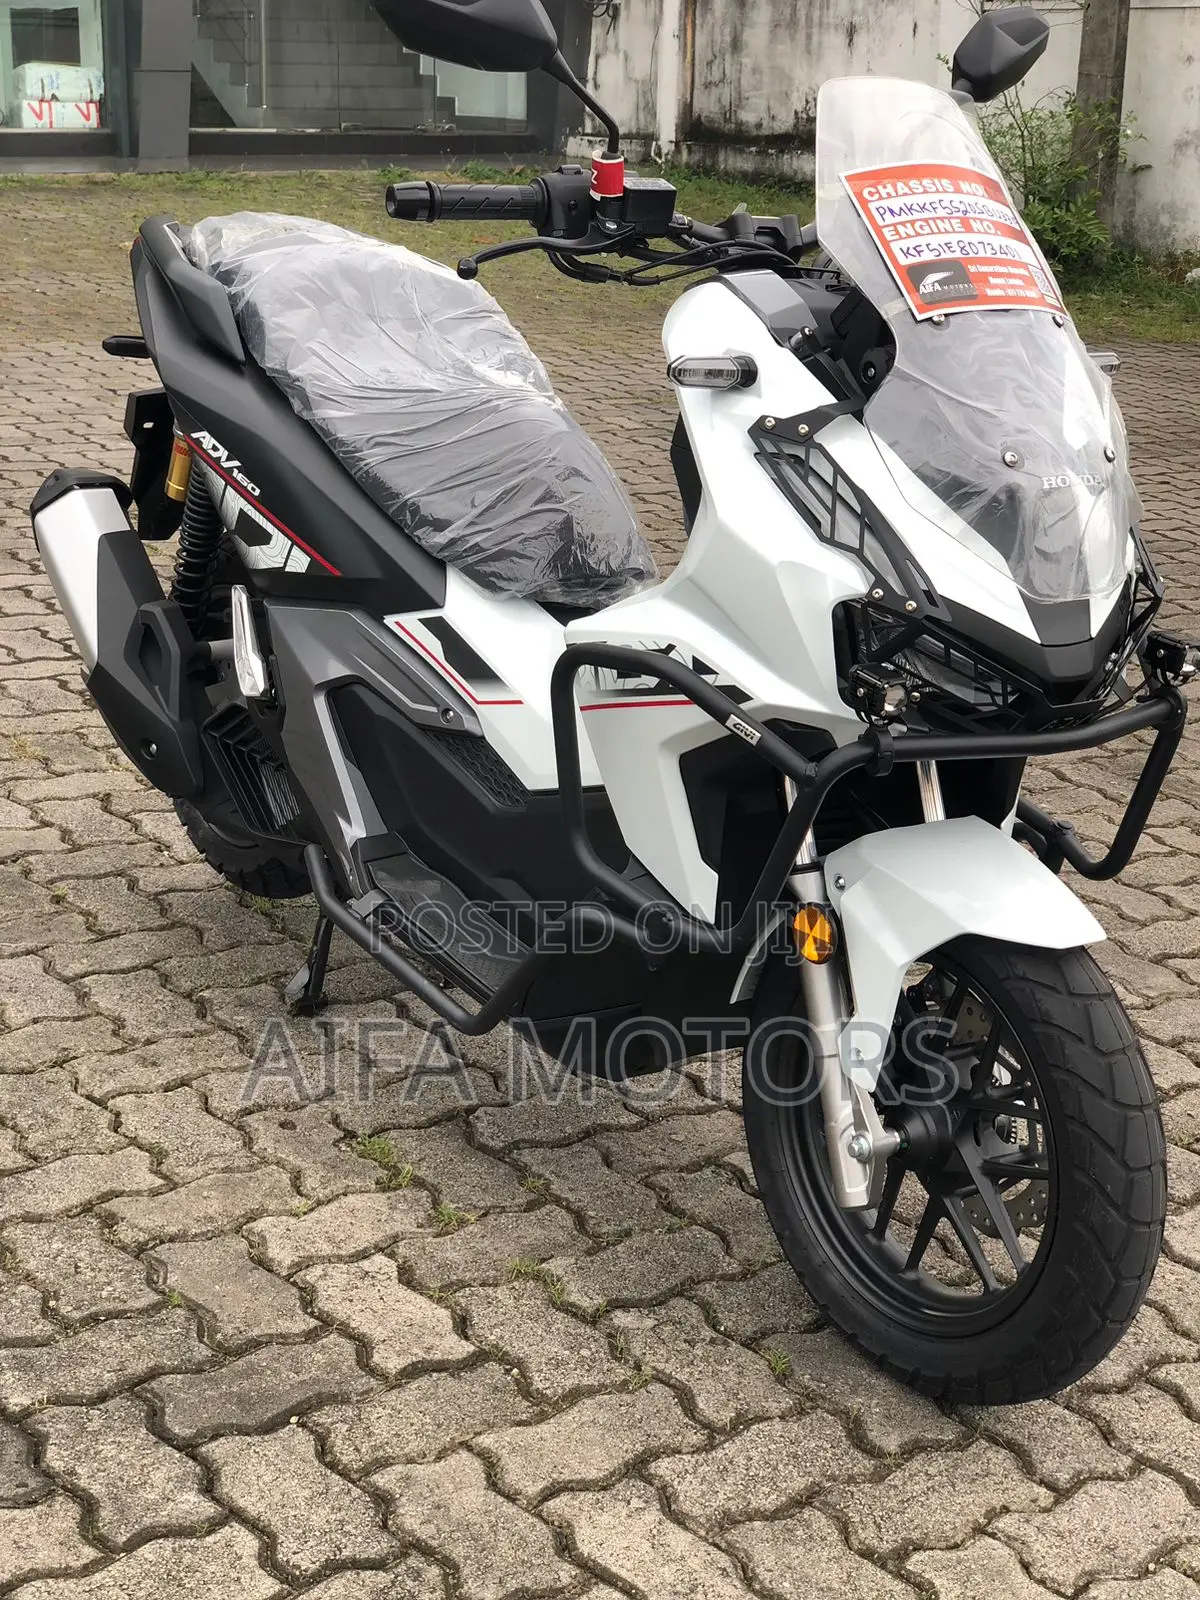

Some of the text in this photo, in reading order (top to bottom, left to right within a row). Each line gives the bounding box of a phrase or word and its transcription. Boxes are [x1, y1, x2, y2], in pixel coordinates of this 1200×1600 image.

[862, 178, 955, 201] CHASSIS
[881, 218, 1002, 241] ENGINE NO.
[919, 282, 942, 295] AIFA
[190, 430, 261, 497] ADV 160
